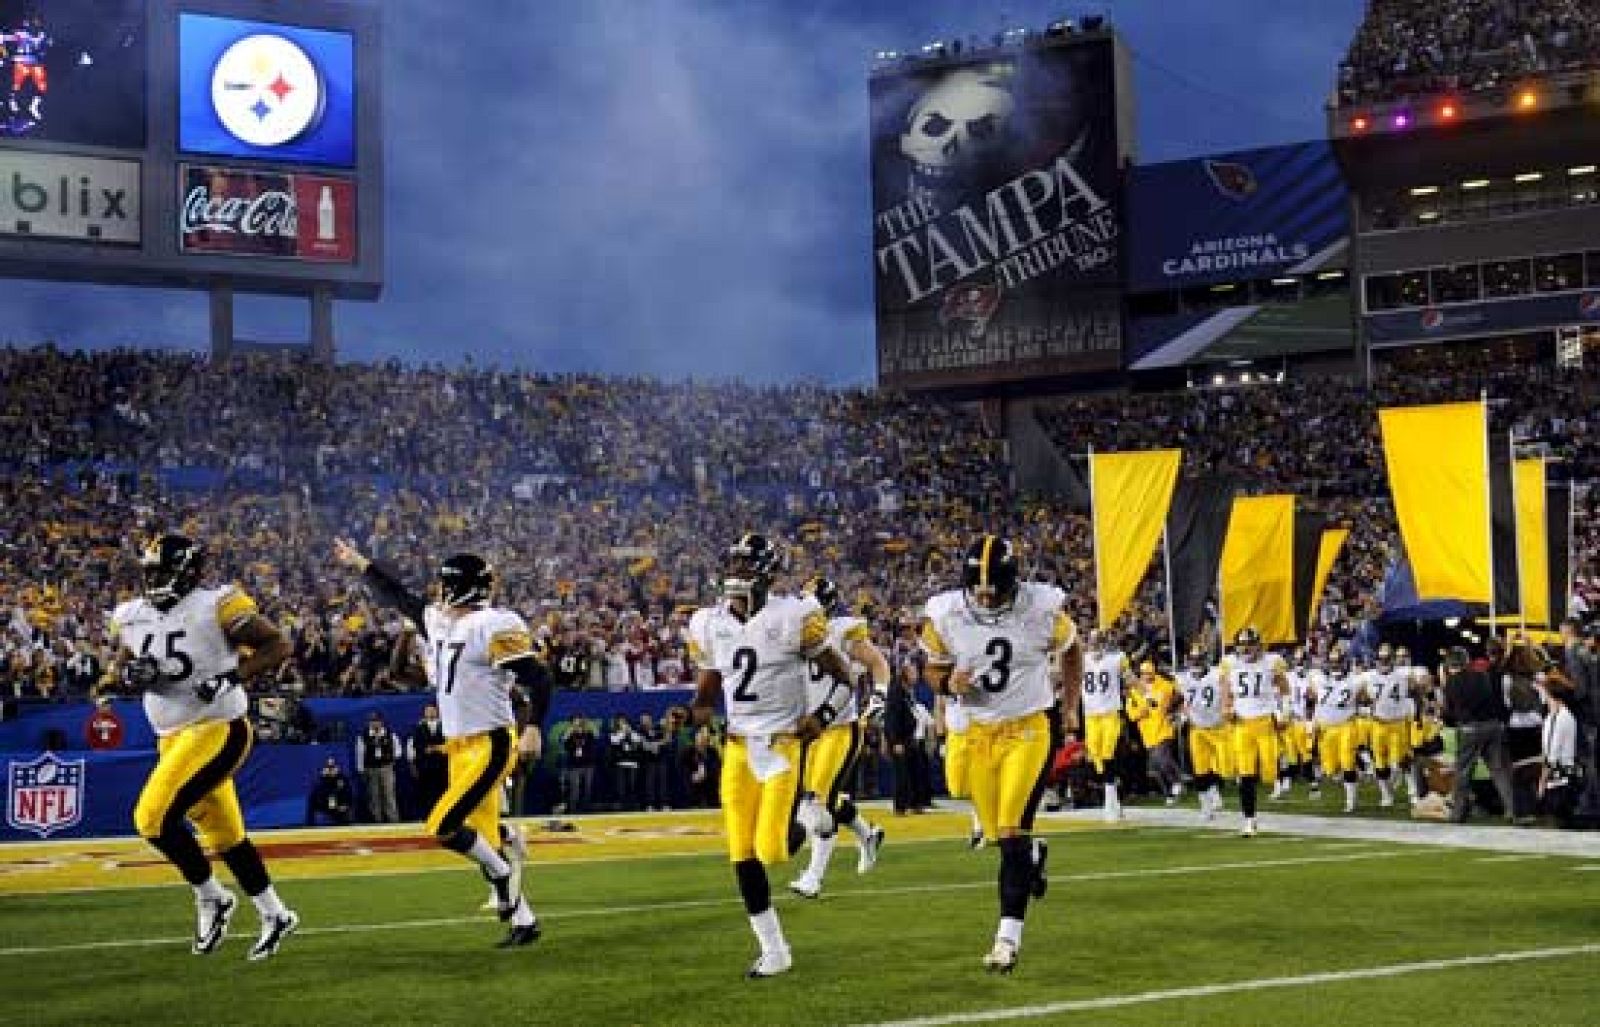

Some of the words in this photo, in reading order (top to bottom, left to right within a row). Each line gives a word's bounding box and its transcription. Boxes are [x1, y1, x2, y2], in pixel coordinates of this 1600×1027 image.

[12, 171, 126, 219] blix
[878, 188, 940, 240] THE
[878, 156, 1108, 303] TAMPA
[995, 208, 1117, 288] TRIBUNE
[1191, 233, 1278, 254] ARIZONA
[1162, 243, 1308, 275] CARDINALS
[733, 647, 759, 702] 2
[981, 637, 1013, 693] 3
[1084, 671, 1110, 693] 89
[1186, 686, 1214, 708] 79
[1373, 683, 1401, 704] 74
[17, 789, 75, 824] NFL
